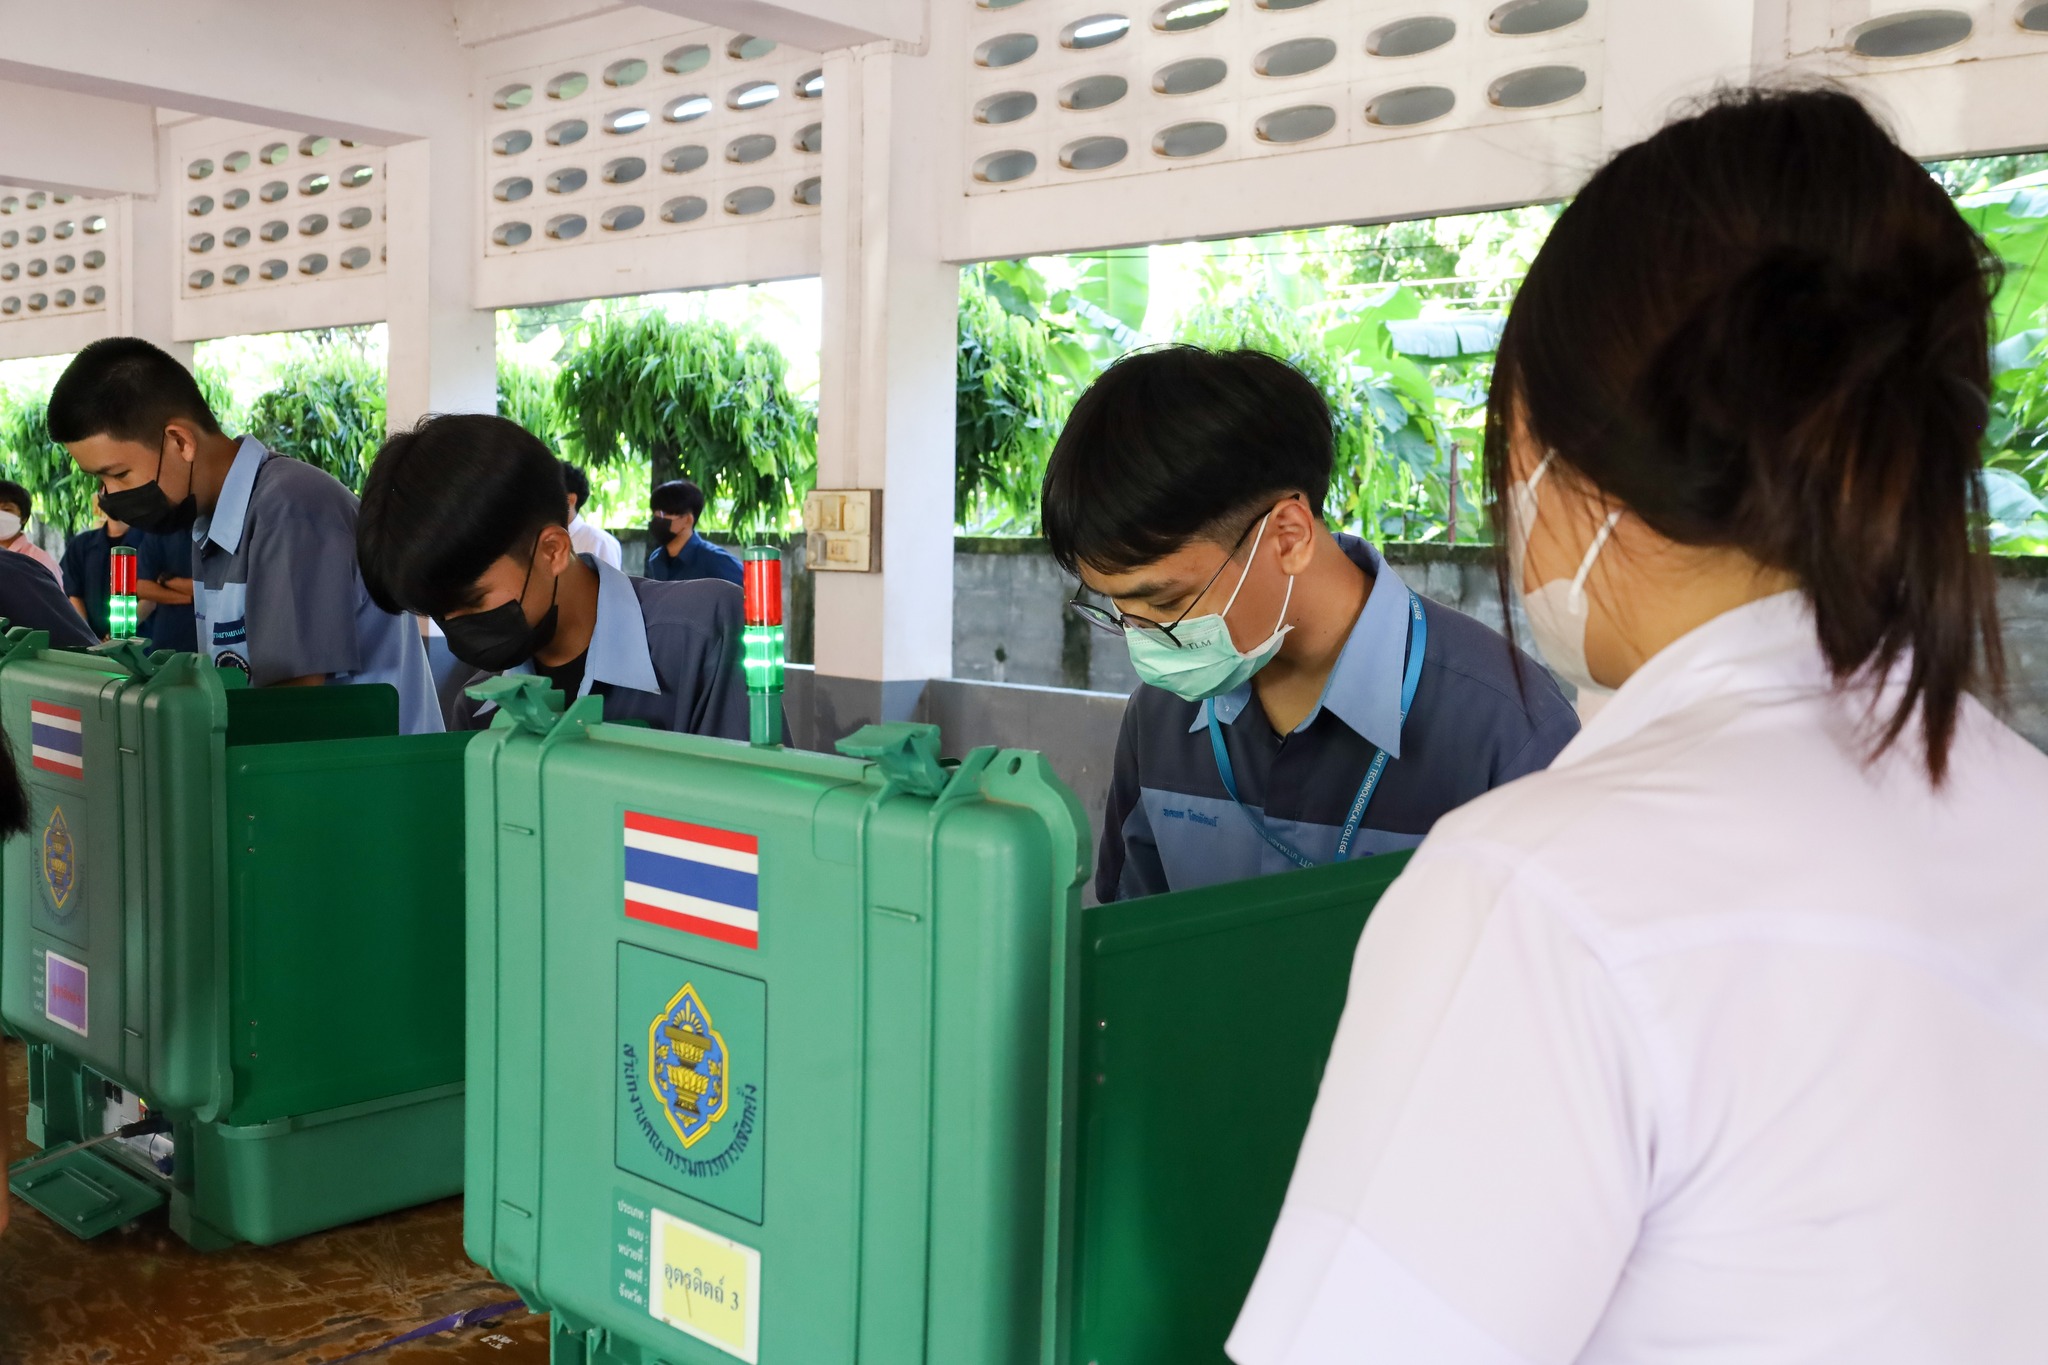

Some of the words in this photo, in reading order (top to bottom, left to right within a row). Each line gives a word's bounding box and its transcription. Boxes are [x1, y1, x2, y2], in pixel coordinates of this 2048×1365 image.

[1349, 768, 1378, 823] TECHNOLOGICAL
[1338, 824, 1354, 854] COLLEGE
[664, 1263, 725, 1304] อุตรดิตถ์
[730, 1291, 739, 1311] 3
